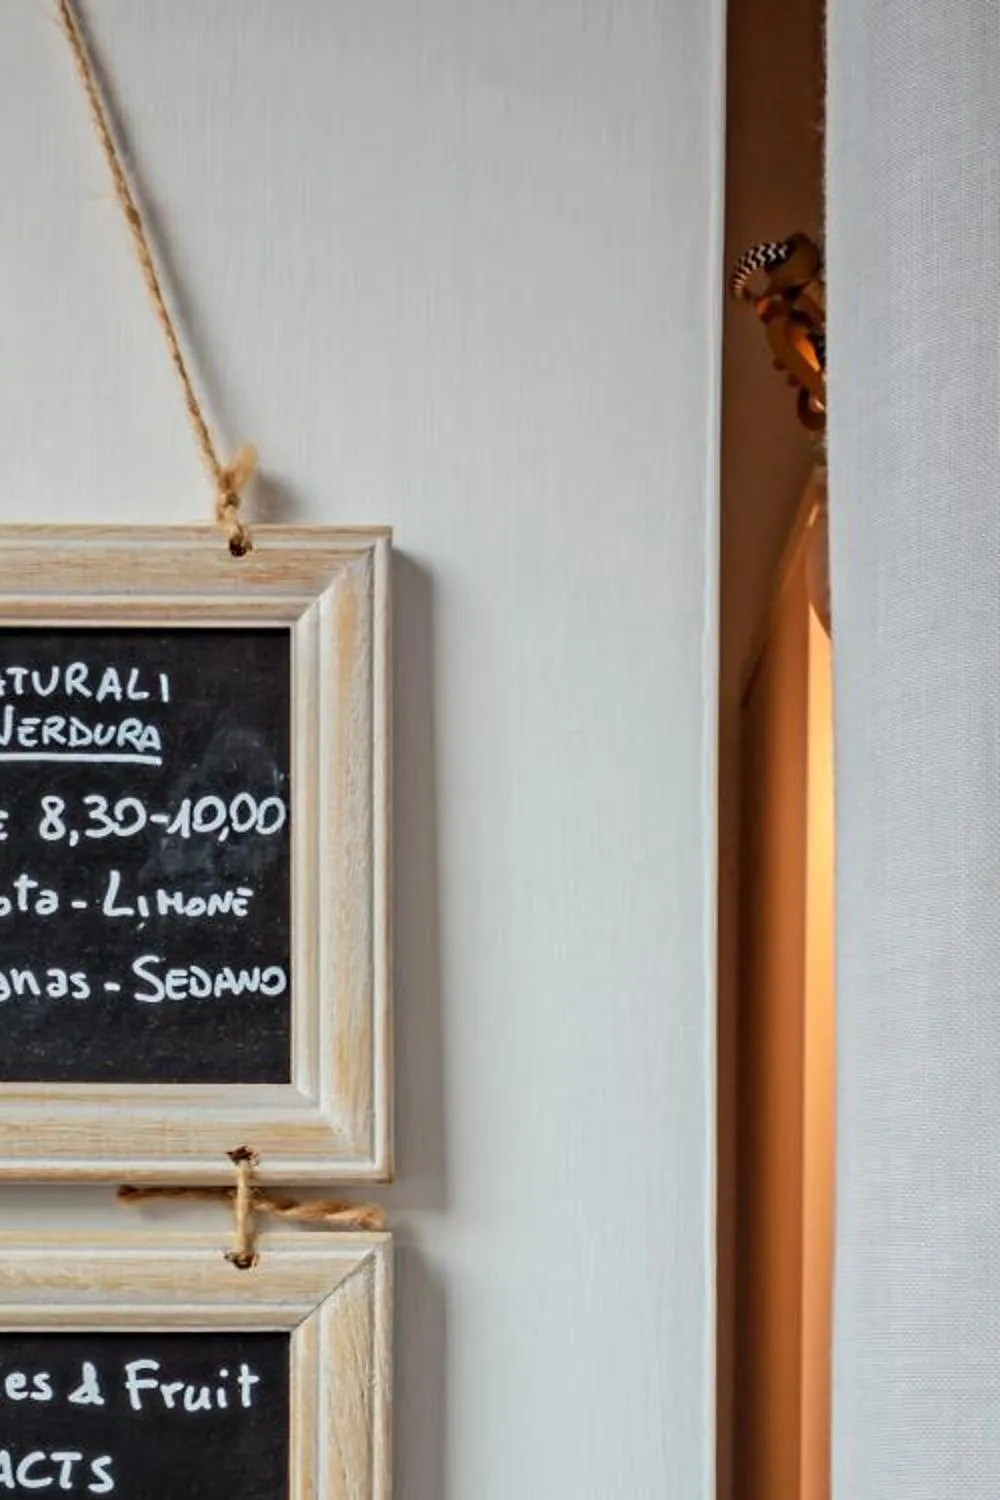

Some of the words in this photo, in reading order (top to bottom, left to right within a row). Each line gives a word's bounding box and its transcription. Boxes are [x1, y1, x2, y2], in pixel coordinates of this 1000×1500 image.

[131, 954, 287, 1003] SEDANO
[67, 1361, 105, 1406] &
[124, 1358, 260, 1412] Fruit
